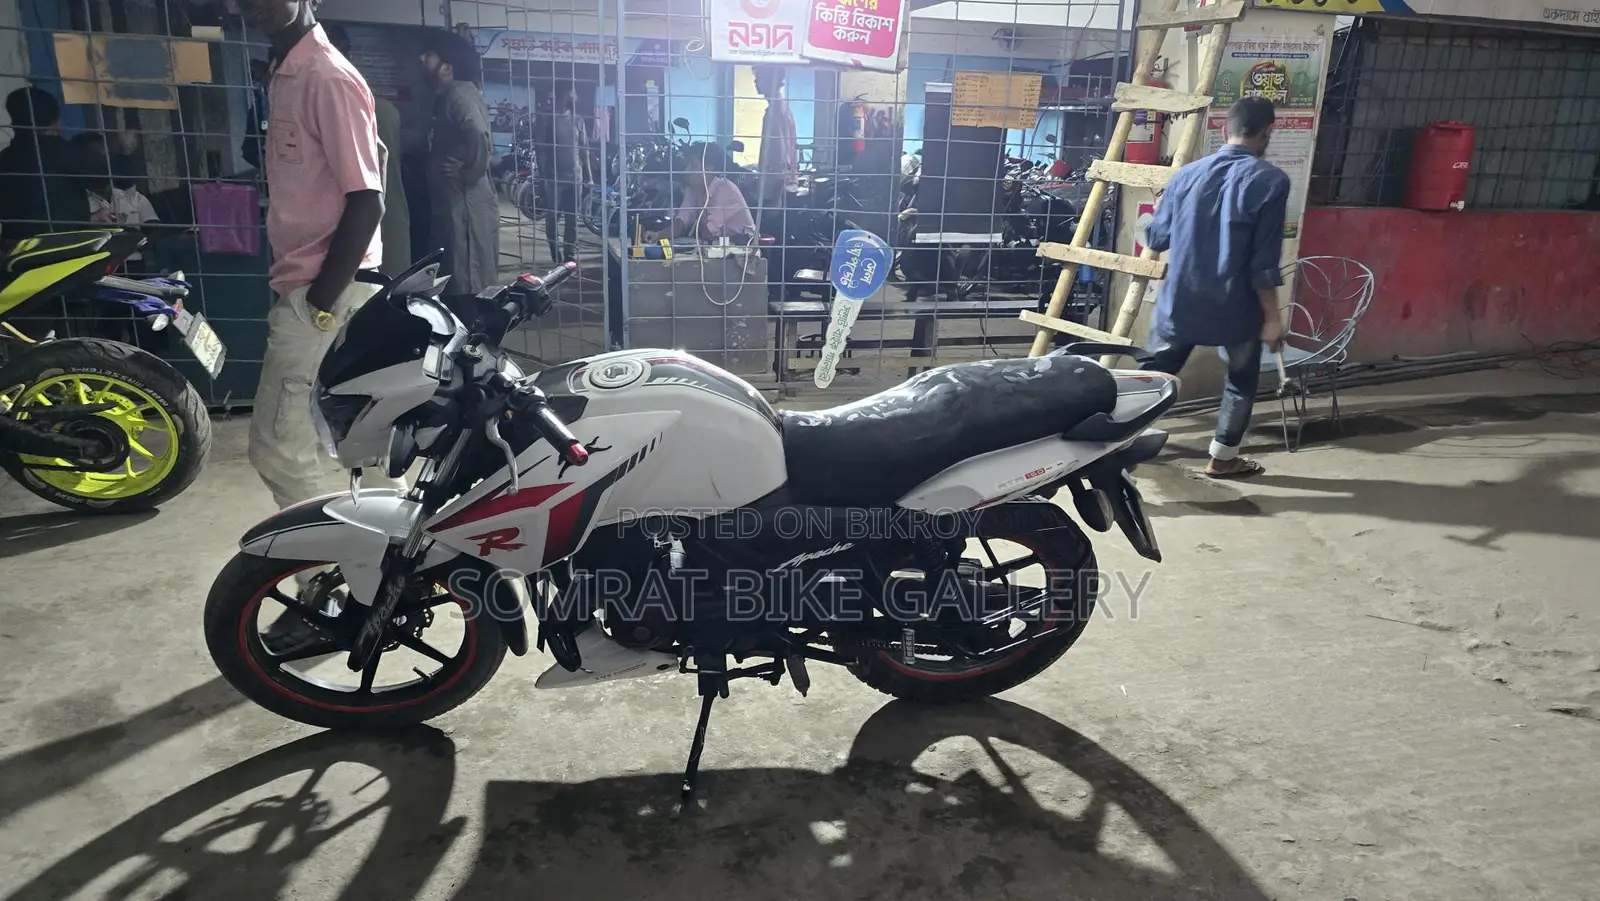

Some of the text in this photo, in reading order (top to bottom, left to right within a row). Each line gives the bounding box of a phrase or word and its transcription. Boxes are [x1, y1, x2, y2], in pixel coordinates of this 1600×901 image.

[815, 2, 895, 32] কিস্তি বিকাশ
[1543, 7, 1580, 21] একদামে
[728, 21, 794, 50] নগদ
[833, 25, 871, 44] করুন
[1252, 71, 1285, 89] ওয়াজ
[837, 305, 851, 328] সম্রাট
[830, 328, 843, 350] বাইক
[773, 541, 856, 573] Apache
